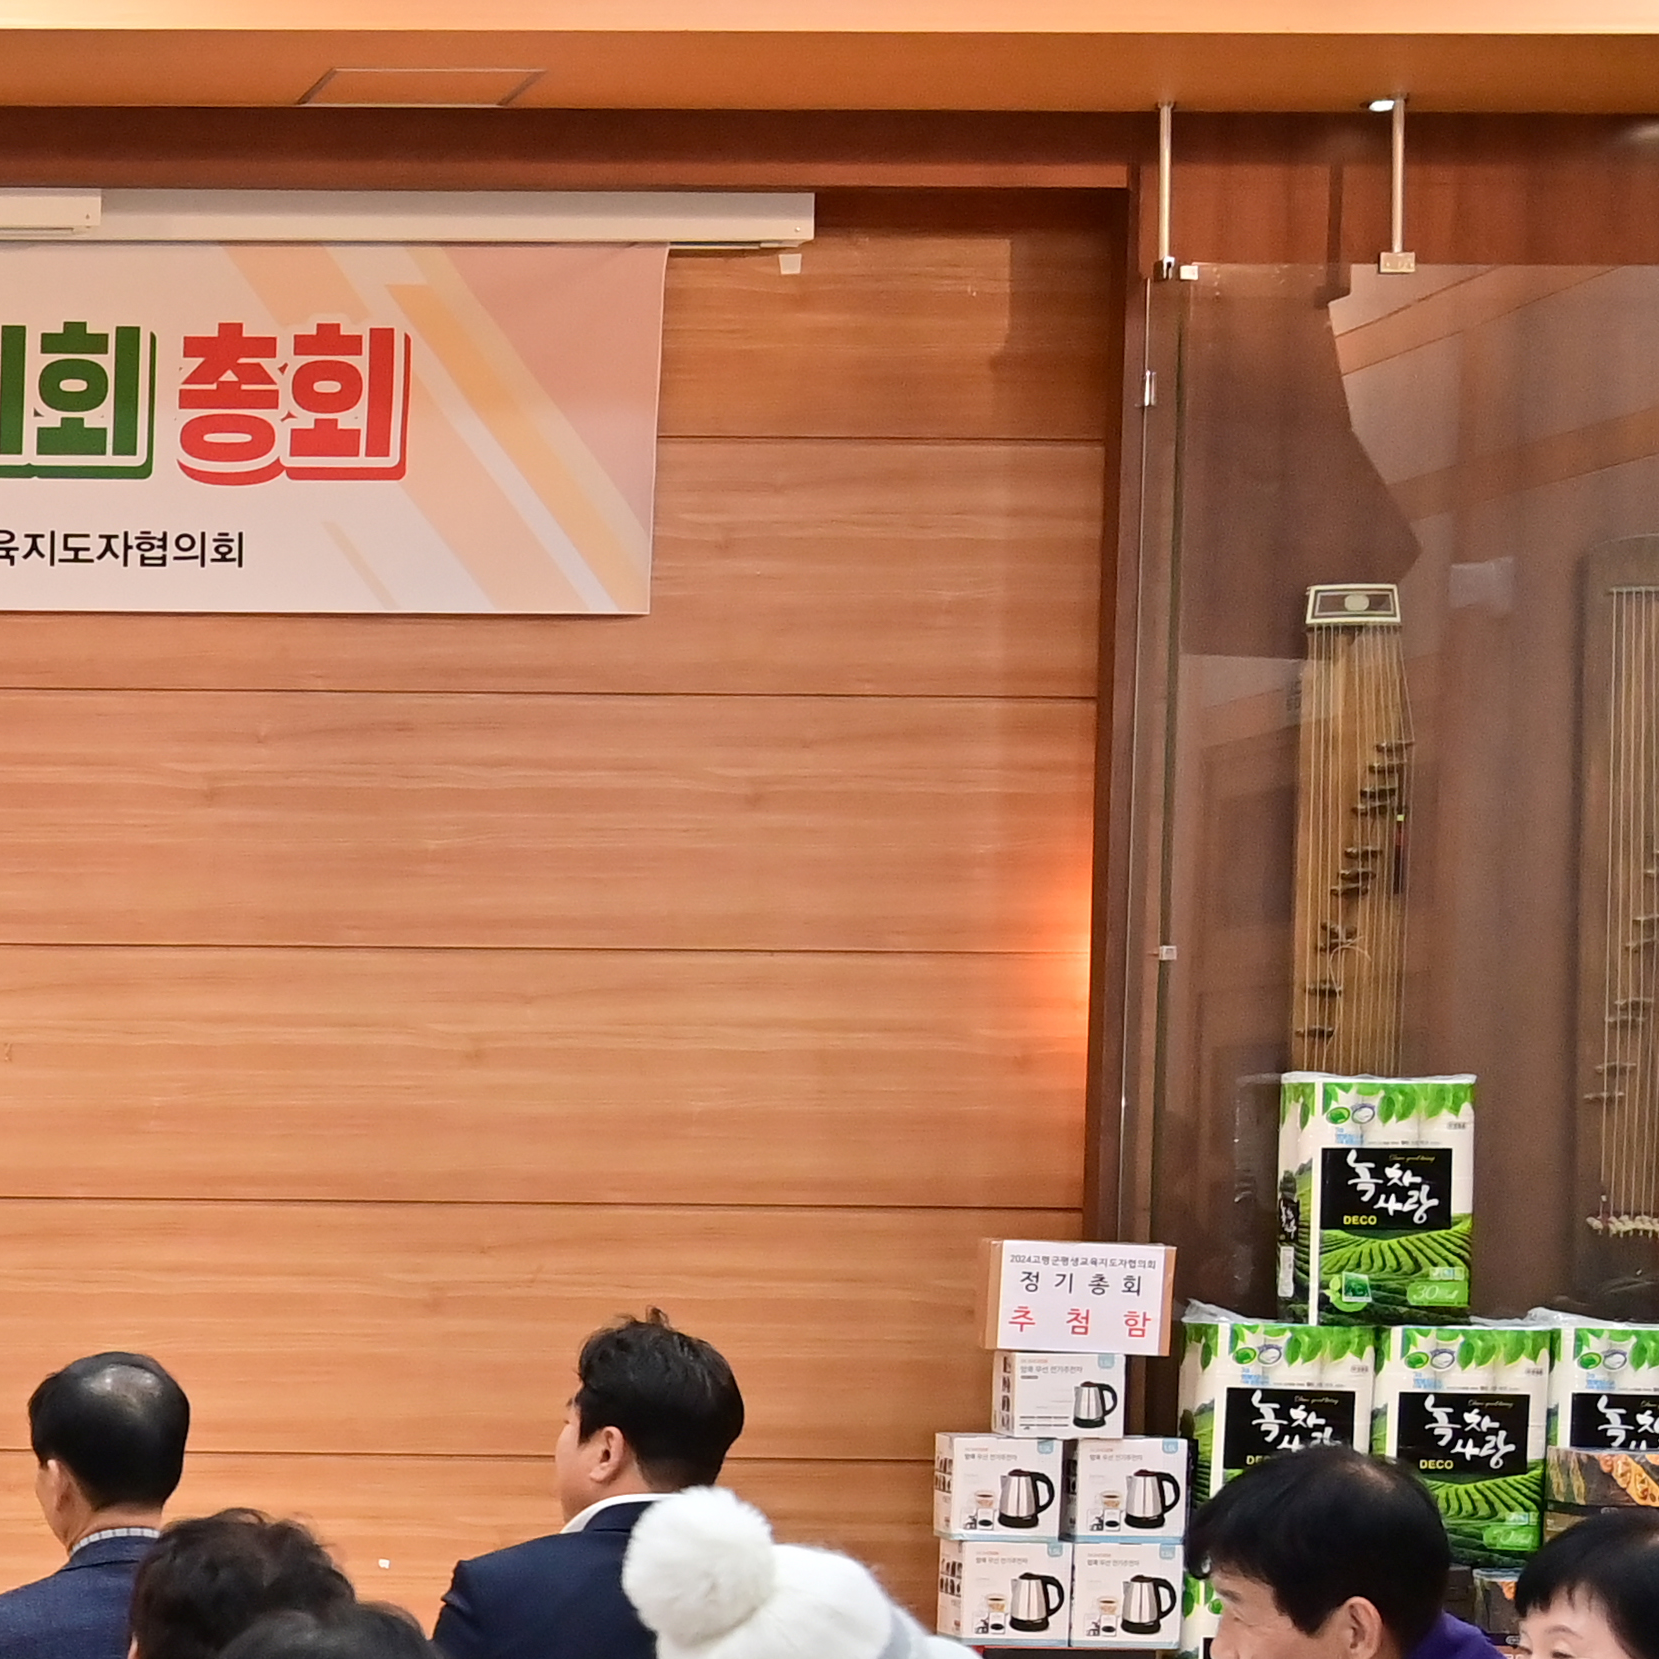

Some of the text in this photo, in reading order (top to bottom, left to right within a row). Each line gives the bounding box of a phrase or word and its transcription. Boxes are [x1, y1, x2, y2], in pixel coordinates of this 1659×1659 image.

[177, 321, 411, 483] 총회
[1343, 1214, 1378, 1226] DECO
[1246, 1455, 1272, 1466] DE
[1419, 1459, 1454, 1471] DECO
